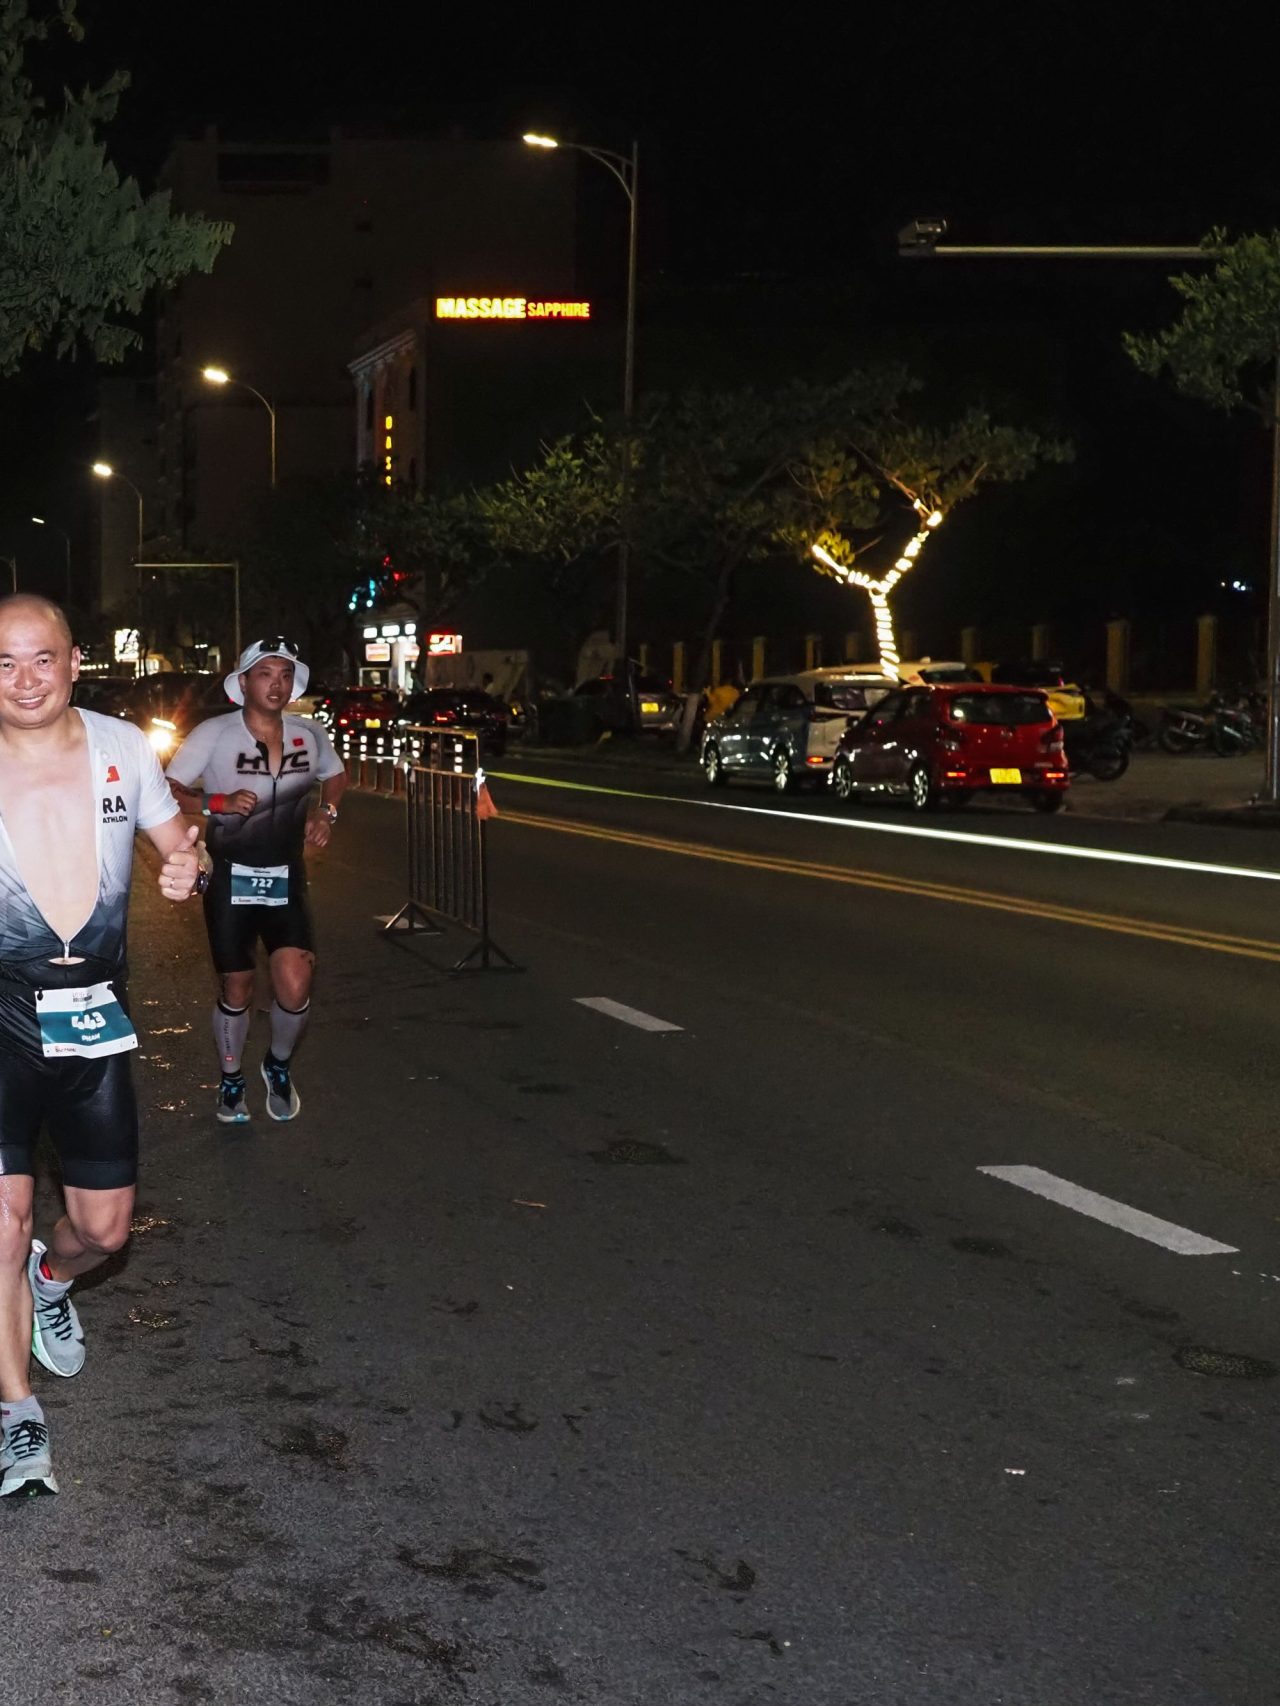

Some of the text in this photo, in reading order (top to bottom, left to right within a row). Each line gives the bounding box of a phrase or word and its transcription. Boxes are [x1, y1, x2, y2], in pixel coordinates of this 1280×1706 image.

[436, 298, 590, 318] MASSAGE SAPPHIRE
[102, 795, 127, 814] RA
[102, 815, 128, 824] ATHLON
[70, 1011, 107, 1031] 443
